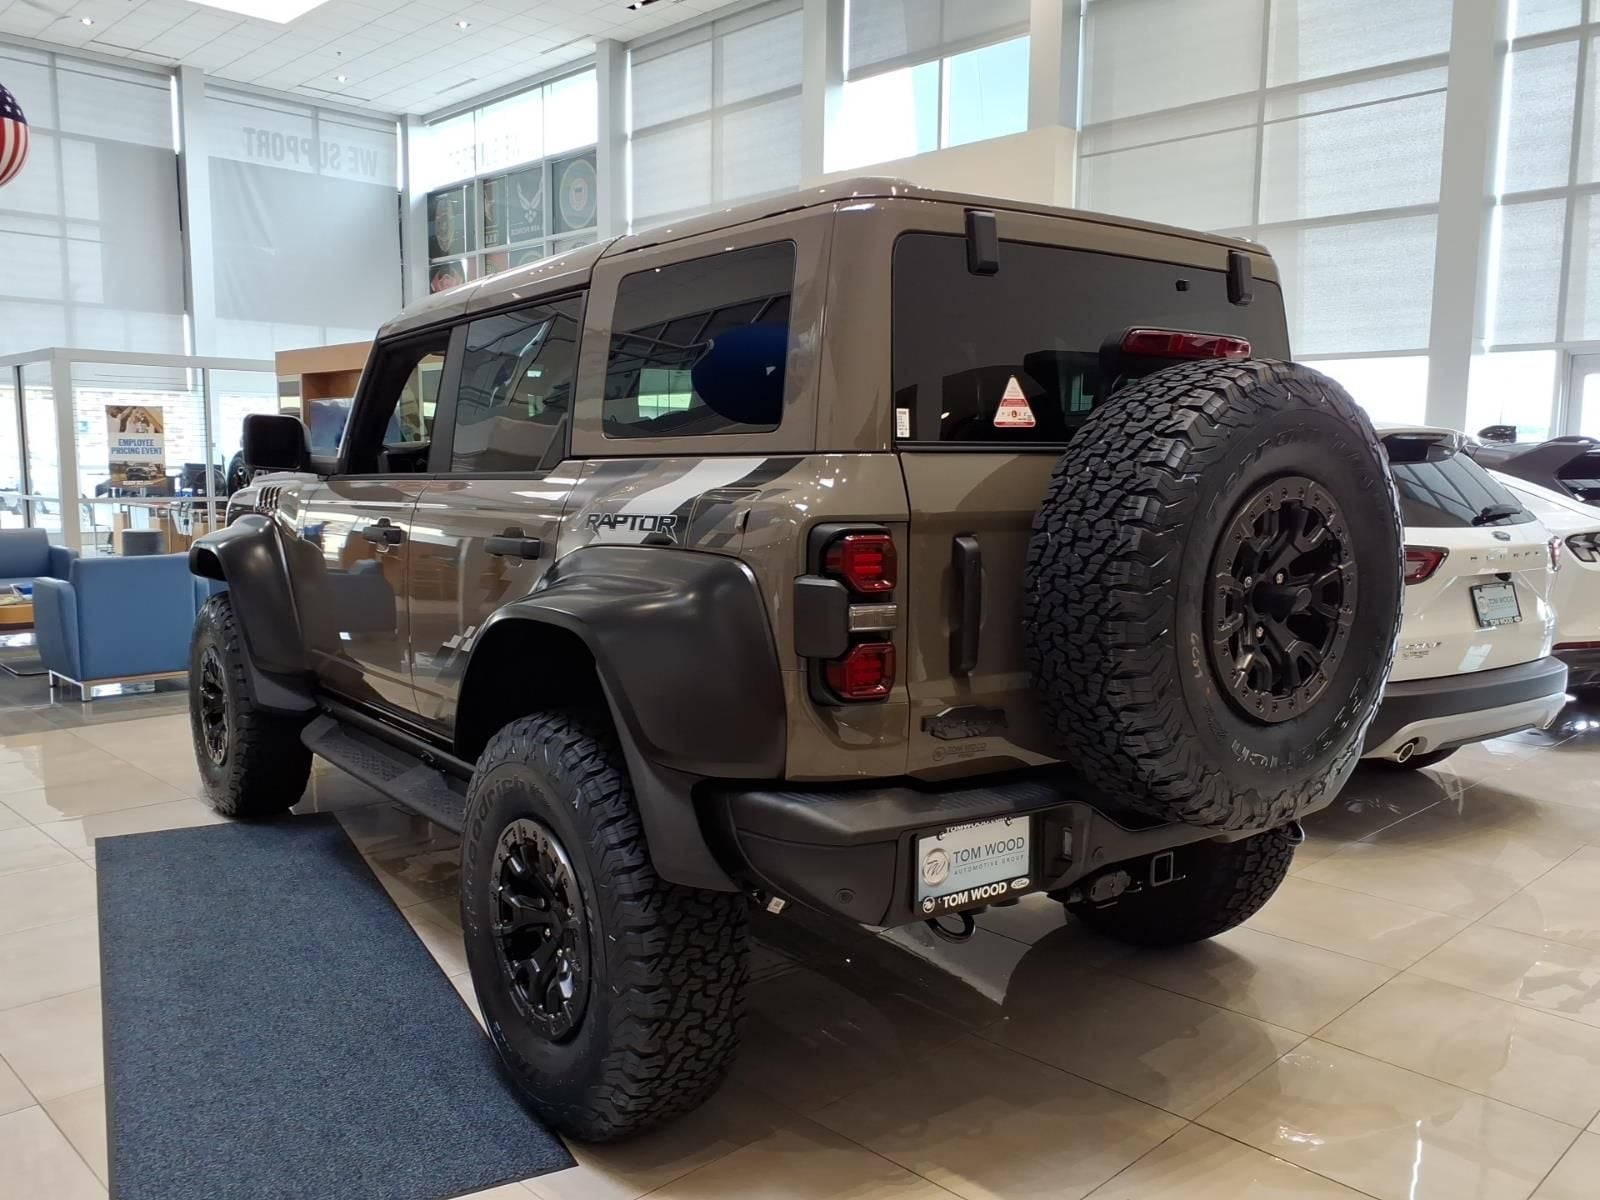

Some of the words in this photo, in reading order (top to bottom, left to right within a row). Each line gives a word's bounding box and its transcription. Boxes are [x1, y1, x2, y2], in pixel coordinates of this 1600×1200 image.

[111, 447, 141, 455] PRICING
[141, 447, 162, 455] EVENT
[118, 439, 154, 447] EMPLOYEE
[585, 513, 679, 543] RAPTOR
[953, 846, 981, 864] TOM
[984, 837, 1025, 857] WOOD
[954, 860, 999, 875] AUTOMOTIVE
[1001, 854, 1025, 865] GROUP
[942, 891, 969, 909] TOM
[970, 881, 1007, 901] WOOD
